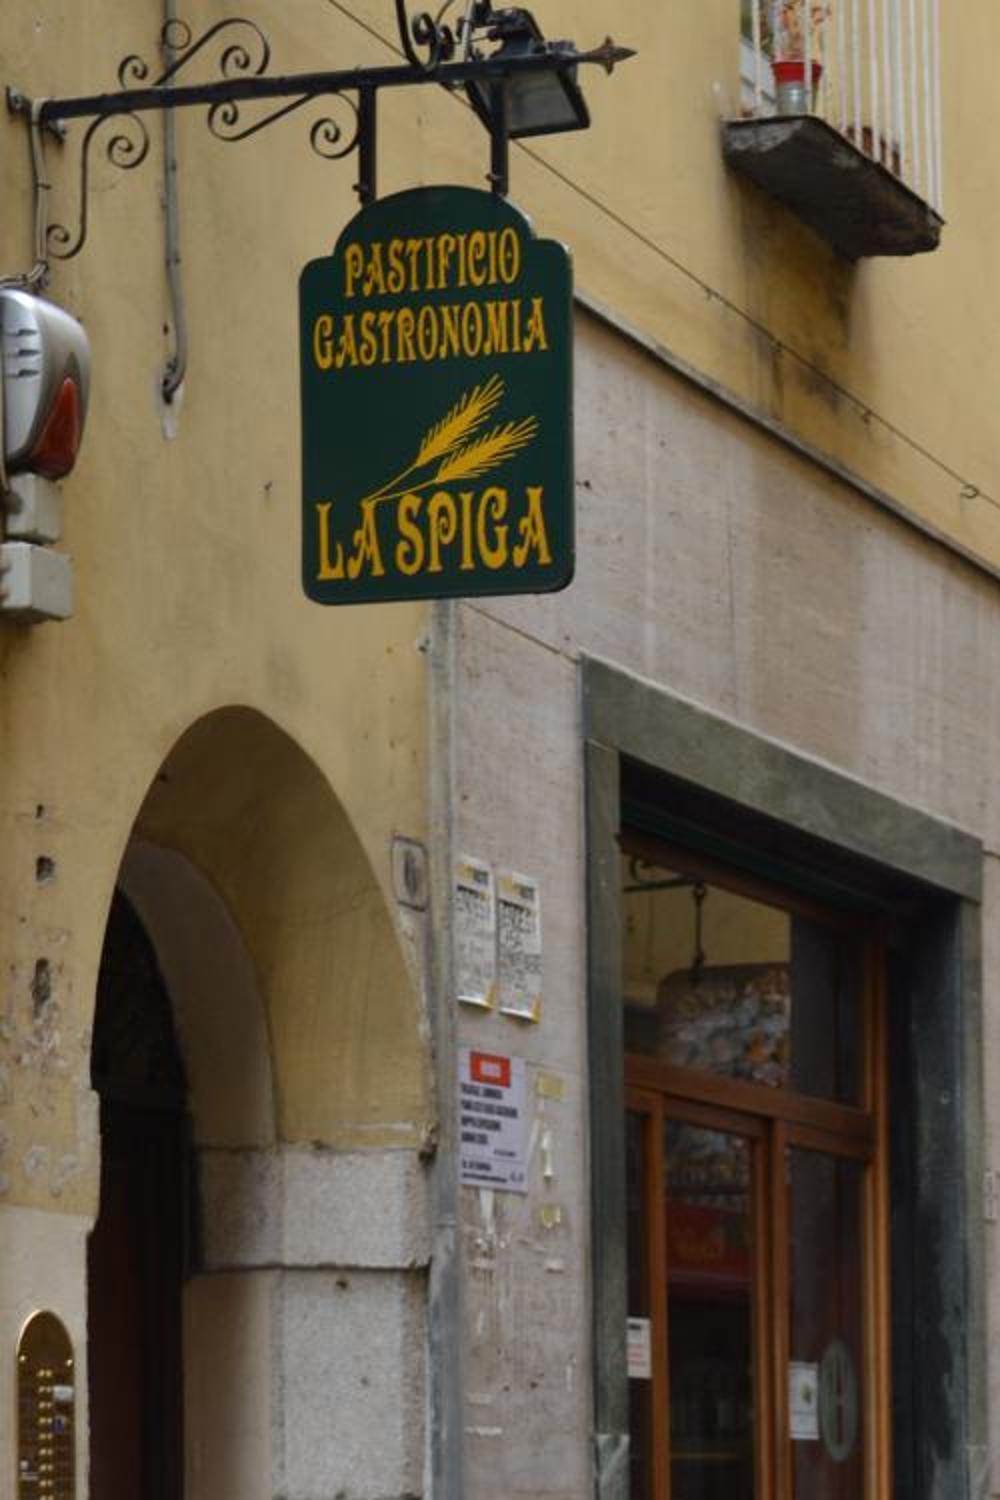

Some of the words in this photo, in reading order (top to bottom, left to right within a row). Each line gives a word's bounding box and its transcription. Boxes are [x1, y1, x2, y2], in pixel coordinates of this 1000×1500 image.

[344, 226, 521, 298] PASTIFICIO
[313, 296, 549, 370] GASTRONOMIA
[316, 500, 385, 581] LA
[395, 486, 553, 577] SPIGA
